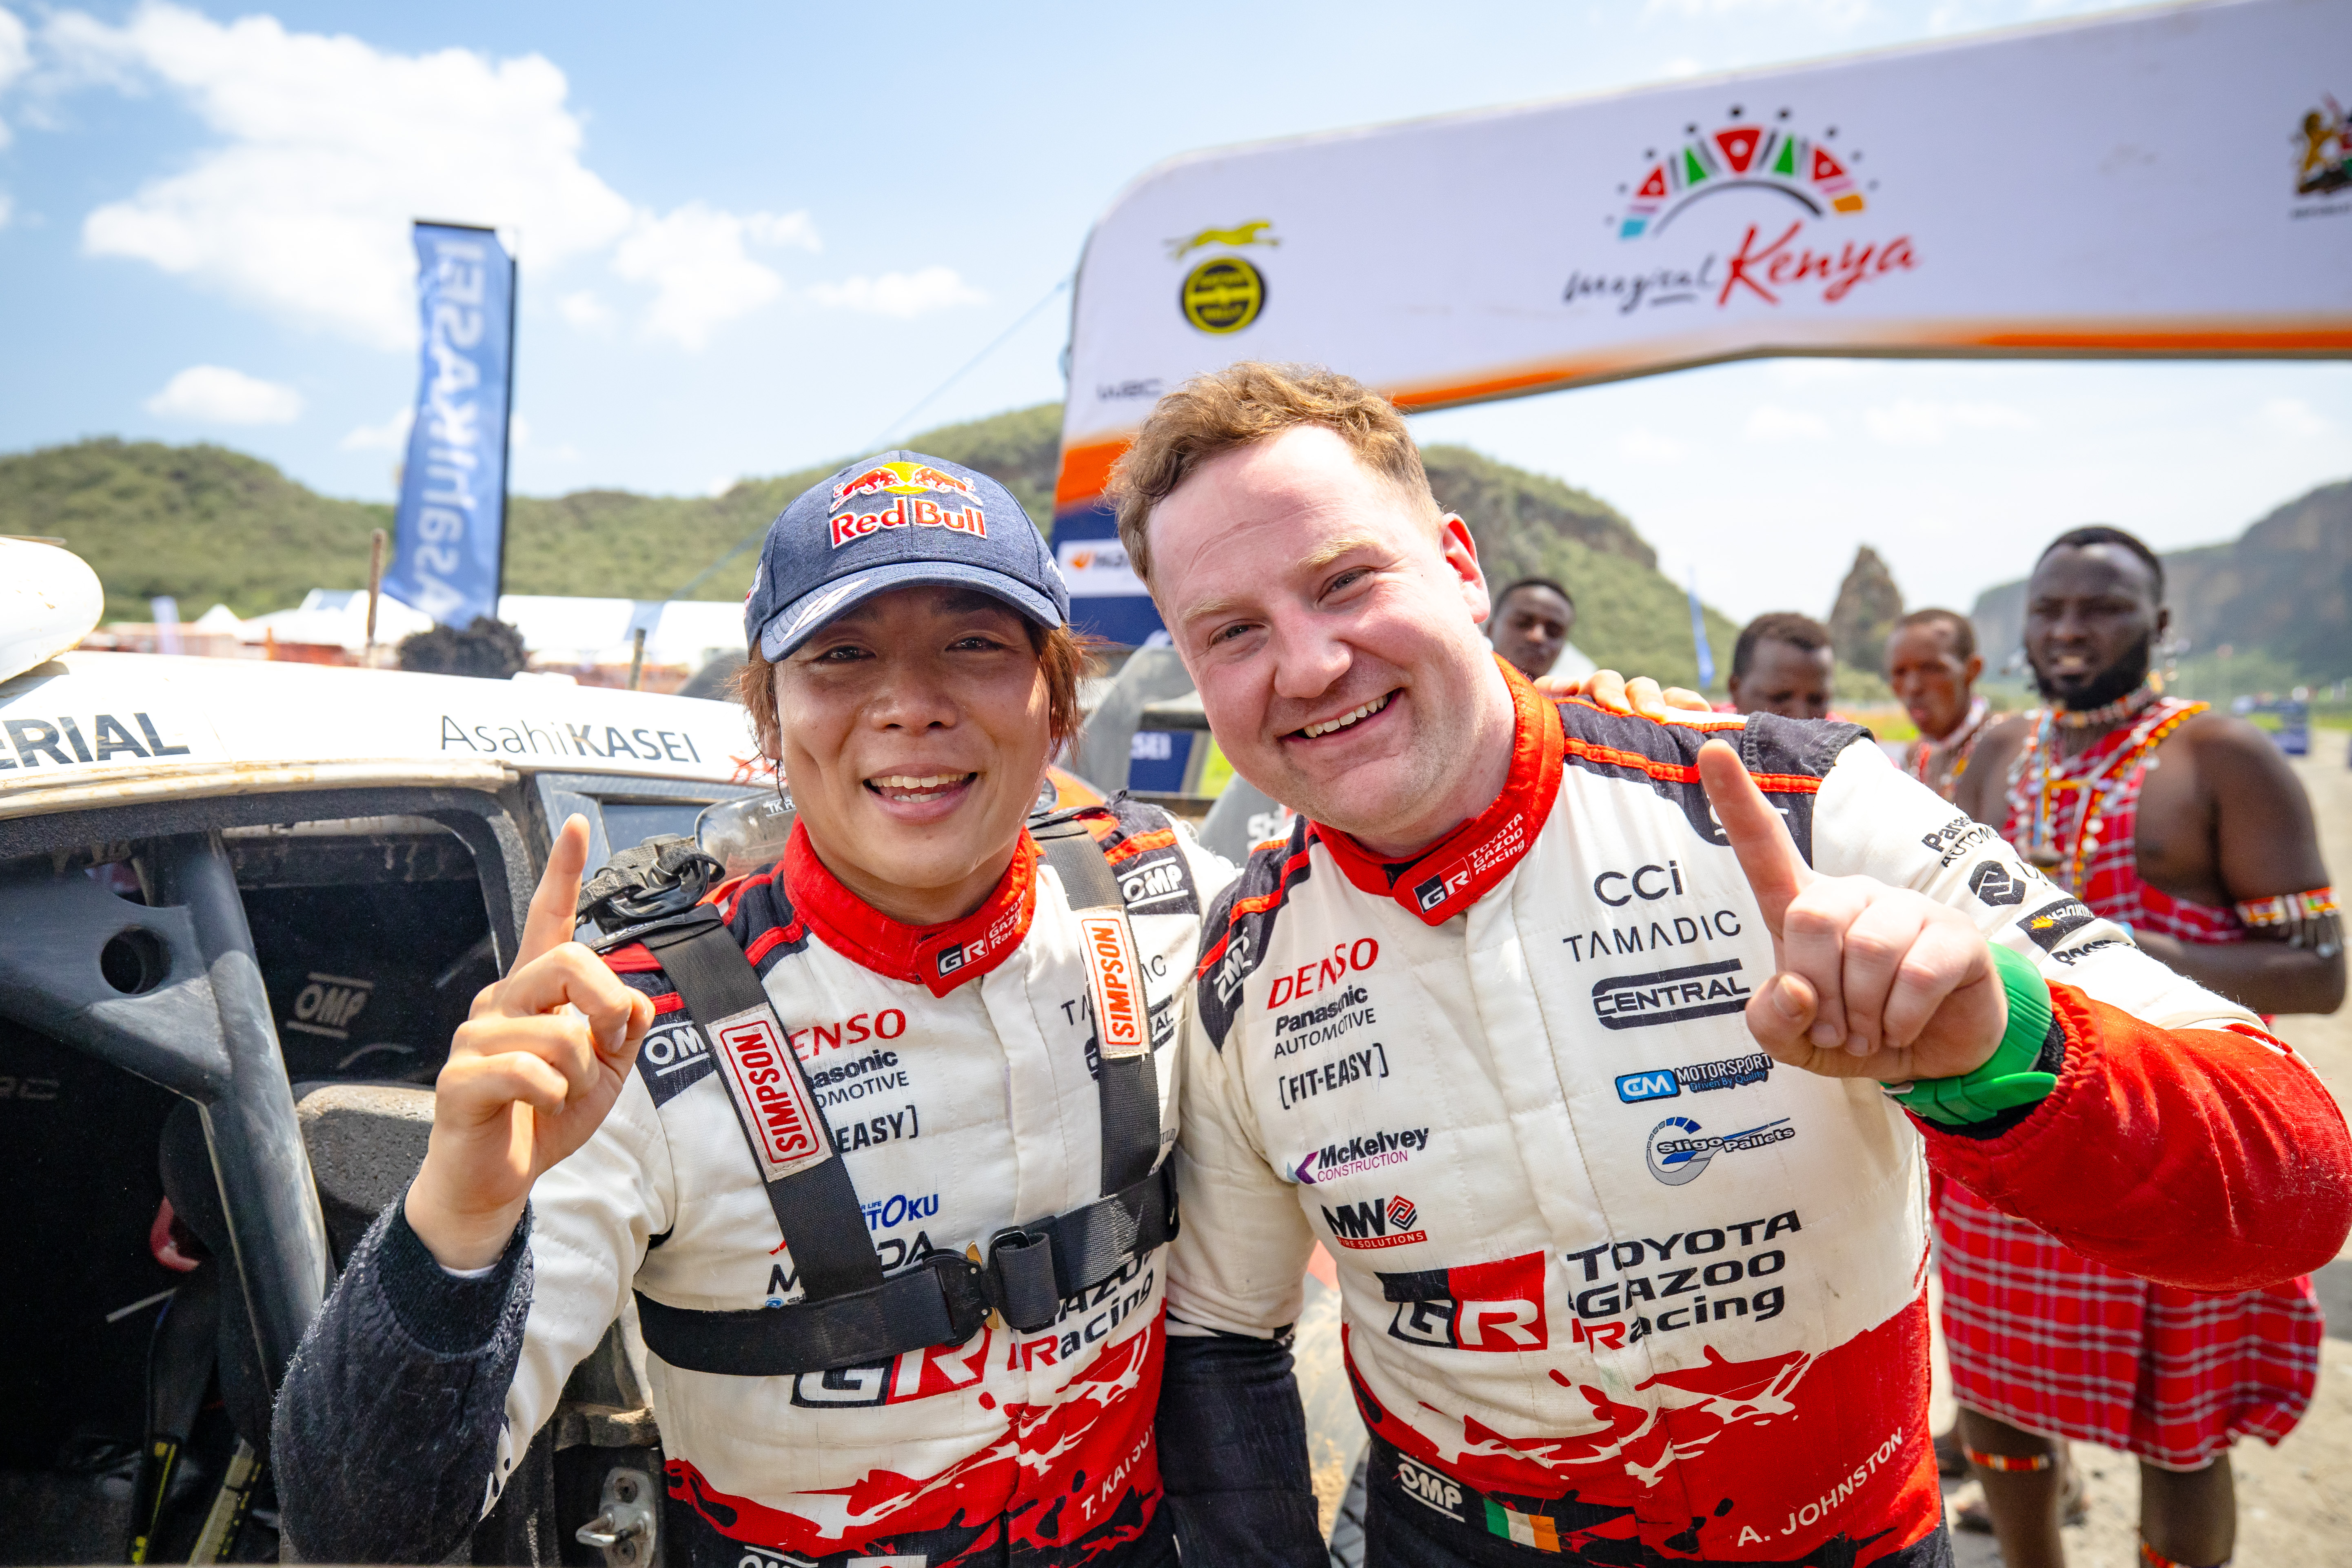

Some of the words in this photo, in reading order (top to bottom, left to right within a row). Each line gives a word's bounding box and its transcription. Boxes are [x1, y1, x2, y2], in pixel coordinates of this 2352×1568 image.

[1716, 220, 1917, 308] Kenya
[830, 497, 909, 548] Red
[912, 498, 987, 539] Bull
[1468, 813, 1523, 859] TOYOTA
[1473, 827, 1523, 869] GAZOO
[1476, 840, 1525, 875] Racing
[1123, 864, 1183, 901] OMP
[1422, 870, 1469, 911] GR
[940, 938, 987, 974] GR
[1563, 910, 1741, 962] TAMADIC
[1092, 927, 1135, 1038] SIMPSON
[1267, 938, 1379, 1010] DENSO
[1593, 976, 1751, 1016] CENTRAL
[294, 982, 369, 1029] OMP
[645, 1027, 706, 1065] OM
[788, 1008, 906, 1062] ENSO
[1274, 1008, 1376, 1060] AUTOMOTIVE
[808, 1049, 899, 1089] asonic
[817, 1071, 910, 1109] OMOTIVE
[1675, 1053, 1772, 1083] MOTORSPORT
[1690, 1079, 1721, 1092] Driven
[1722, 1077, 1733, 1089] By
[1735, 1070, 1766, 1083] Quality
[732, 1032, 808, 1153] SIMPSON
[1318, 1127, 1429, 1170] McKelvey
[1657, 1136, 1724, 1154] Sligo
[1724, 1127, 1796, 1153] Pallets
[1318, 1149, 1408, 1182] CONSTRUCTION
[868, 1201, 881, 1209] LIFE
[1358, 1231, 1425, 1248] SOLUTIONS
[1567, 1209, 1802, 1282] TOYOTA
[1568, 1249, 1786, 1320] GAZOO
[1007, 1268, 1154, 1372] Racing
[1396, 1298, 1541, 1346] GR
[1572, 1285, 1785, 1354] Racing
[1081, 1494, 1096, 1521] T.
[1398, 1463, 1463, 1510] OMP
[1737, 1526, 1771, 1547] A.
[1780, 1427, 1903, 1535] JOHNSTON
